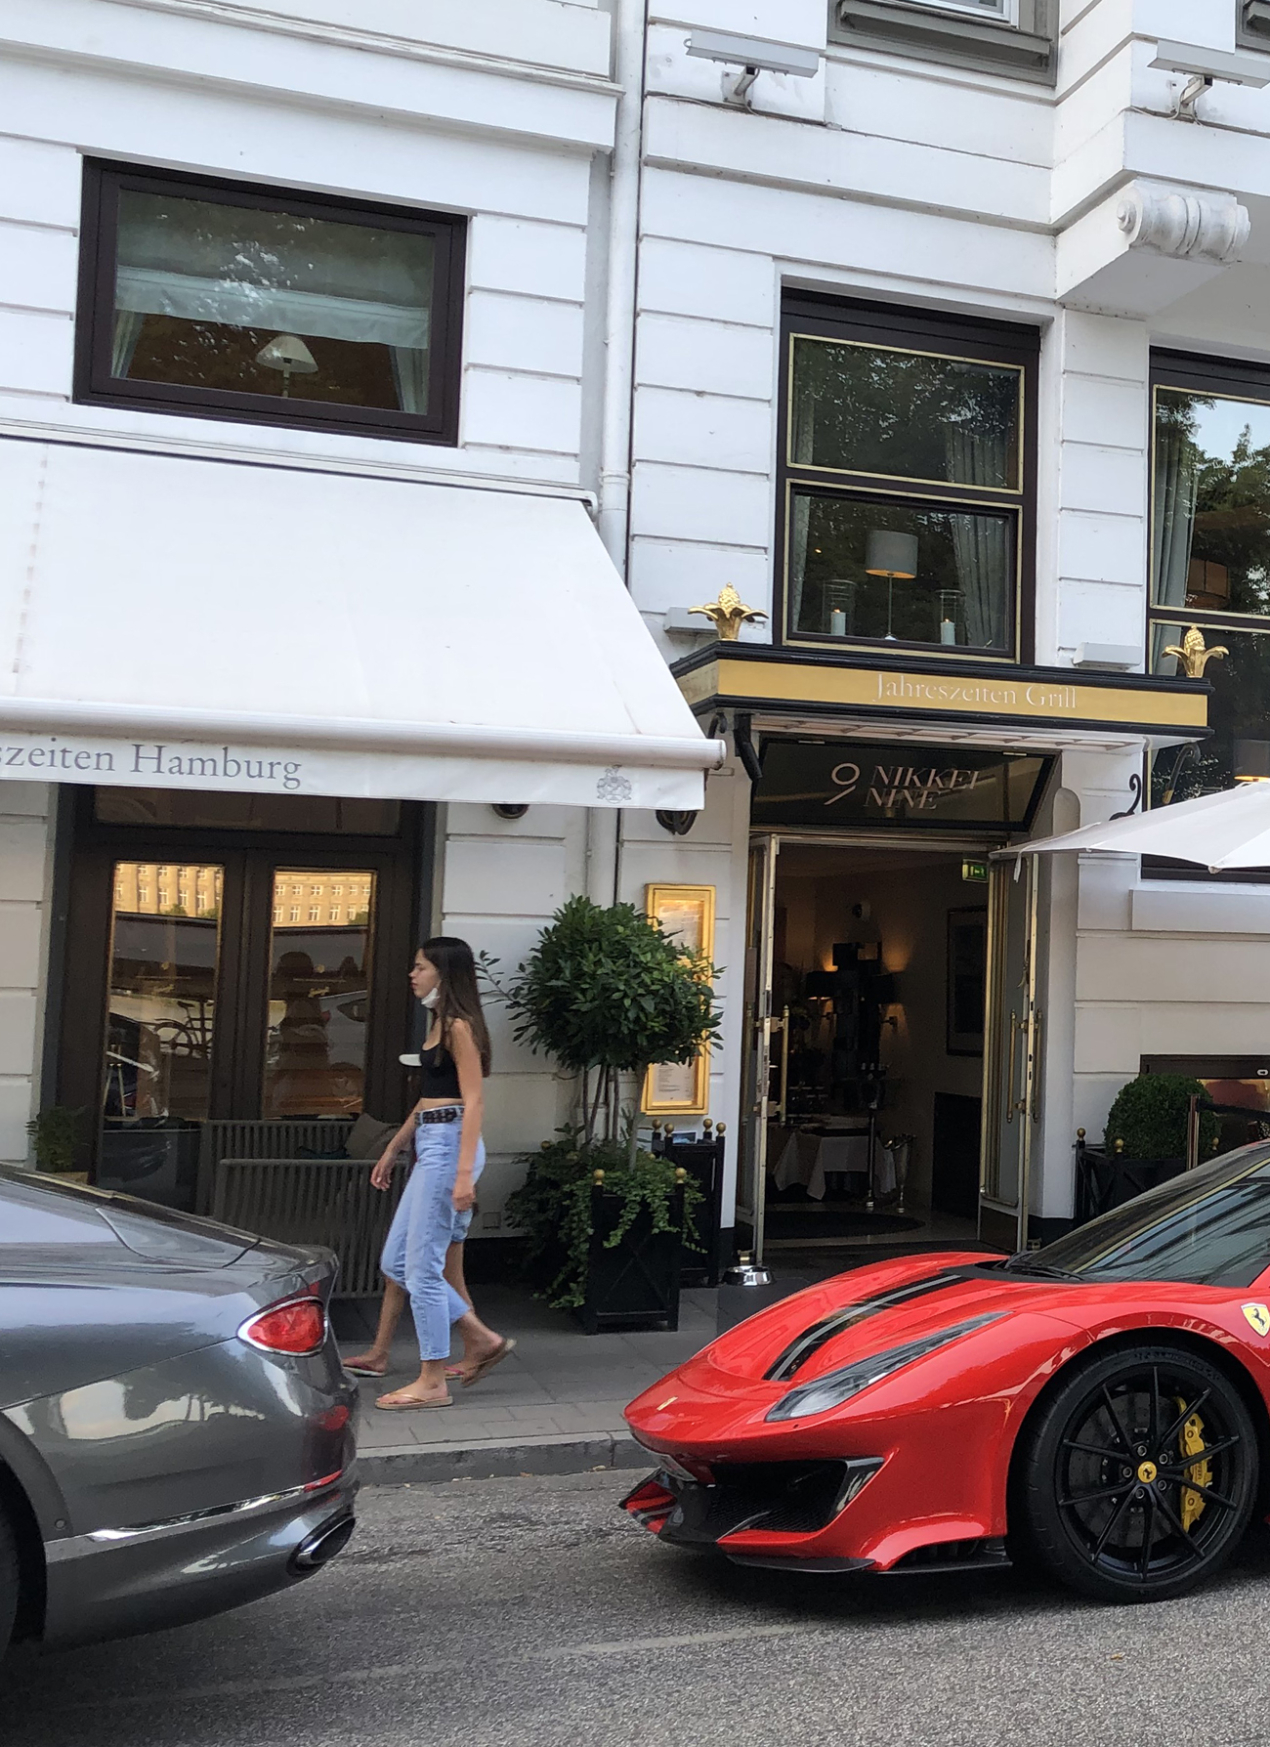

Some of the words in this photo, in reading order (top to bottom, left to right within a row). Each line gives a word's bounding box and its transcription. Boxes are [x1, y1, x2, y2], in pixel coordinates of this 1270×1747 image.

[873, 674, 1016, 704] Jahreszeiten
[1026, 685, 1076, 708] Grill
[0, 737, 116, 772] zeiten
[130, 743, 302, 790] Hamburg
[871, 765, 980, 790] NIKKEI
[824, 762, 860, 806] 9
[862, 787, 942, 810] NINE
